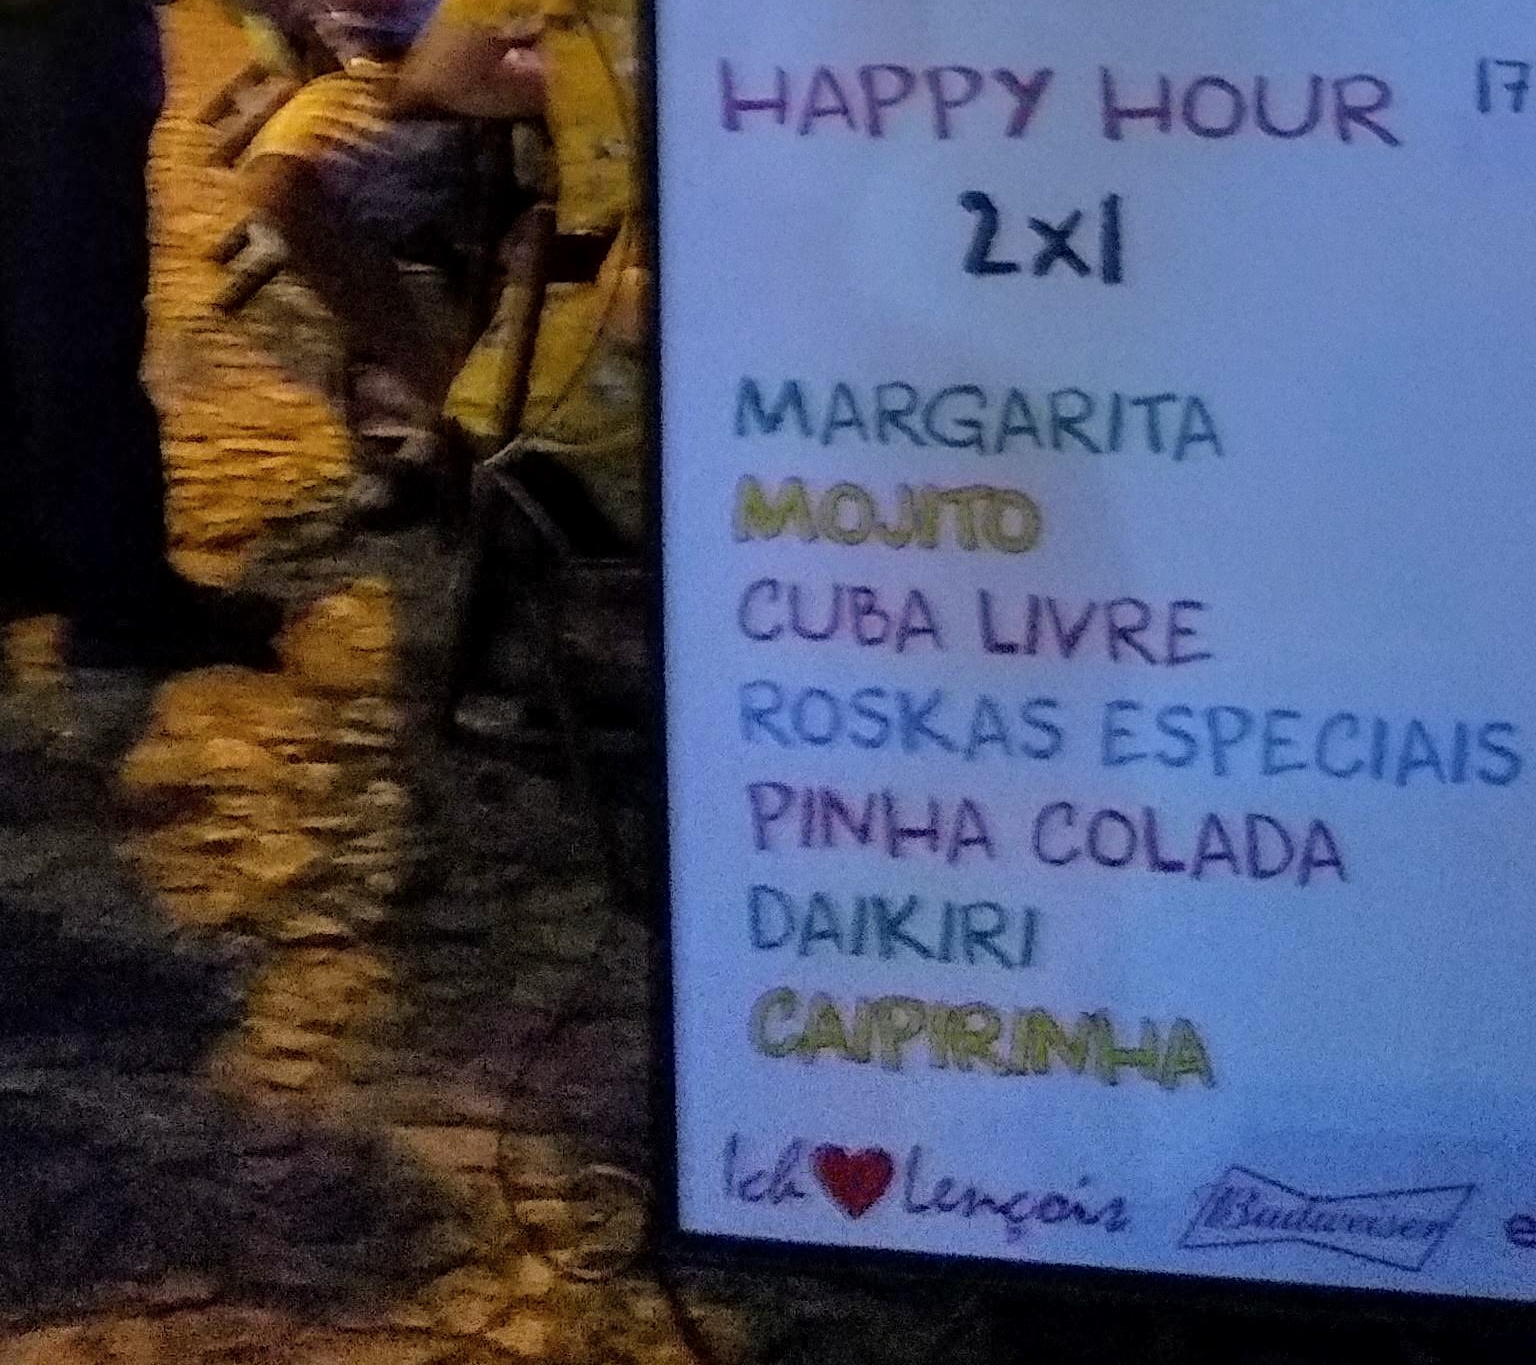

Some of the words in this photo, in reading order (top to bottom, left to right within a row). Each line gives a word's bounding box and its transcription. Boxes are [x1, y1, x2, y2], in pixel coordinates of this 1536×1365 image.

[718, 57, 1053, 139] HAPPY
[1098, 65, 1404, 148] HOUR
[732, 375, 1226, 461] MARGARITA
[731, 473, 1044, 556] MOJITO
[735, 576, 945, 655] CUBA
[976, 587, 1214, 668] LIVRE
[738, 677, 1066, 762] ROSKAS
[1099, 698, 1524, 789] ESPECIAIS
[746, 780, 998, 866] PINHA
[1031, 800, 1351, 887] COLADA
[747, 884, 1041, 970] DAIKIRI
